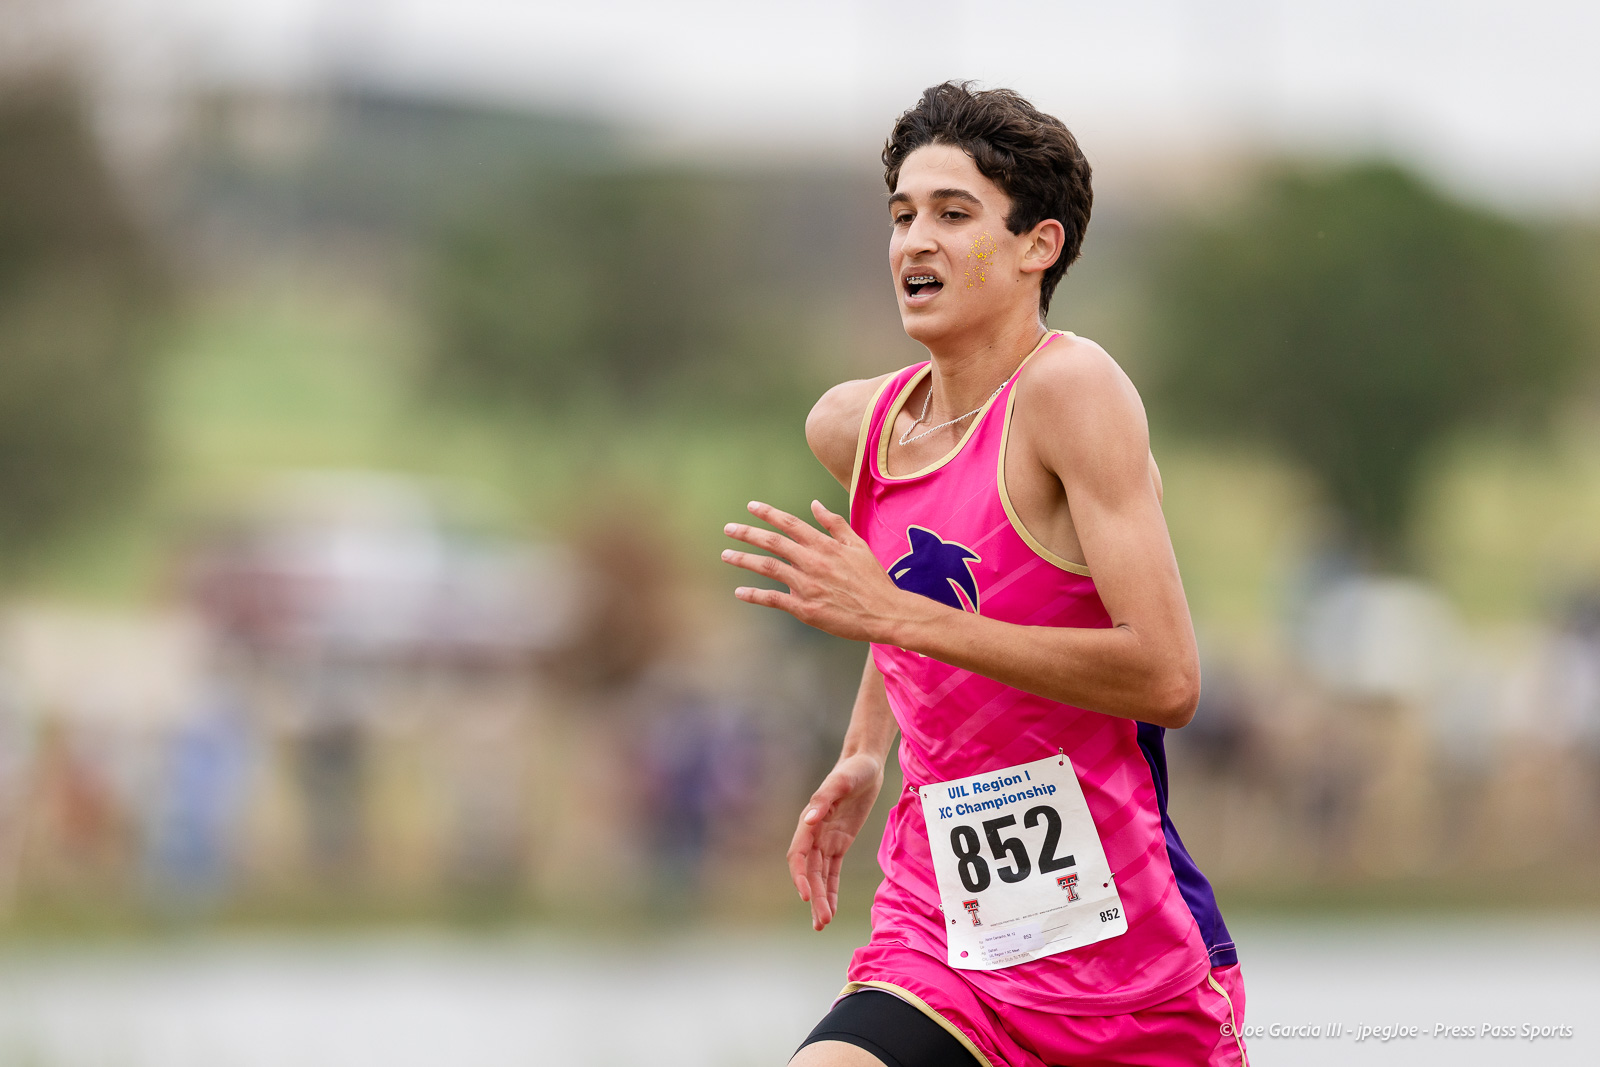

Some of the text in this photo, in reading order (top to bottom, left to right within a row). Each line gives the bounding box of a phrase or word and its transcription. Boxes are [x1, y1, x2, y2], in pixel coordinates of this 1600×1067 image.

[938, 783, 1057, 819] XC Championship
[947, 770, 1031, 800] UIL Region I
[949, 805, 1077, 893] 852
[1099, 907, 1121, 923] 852
